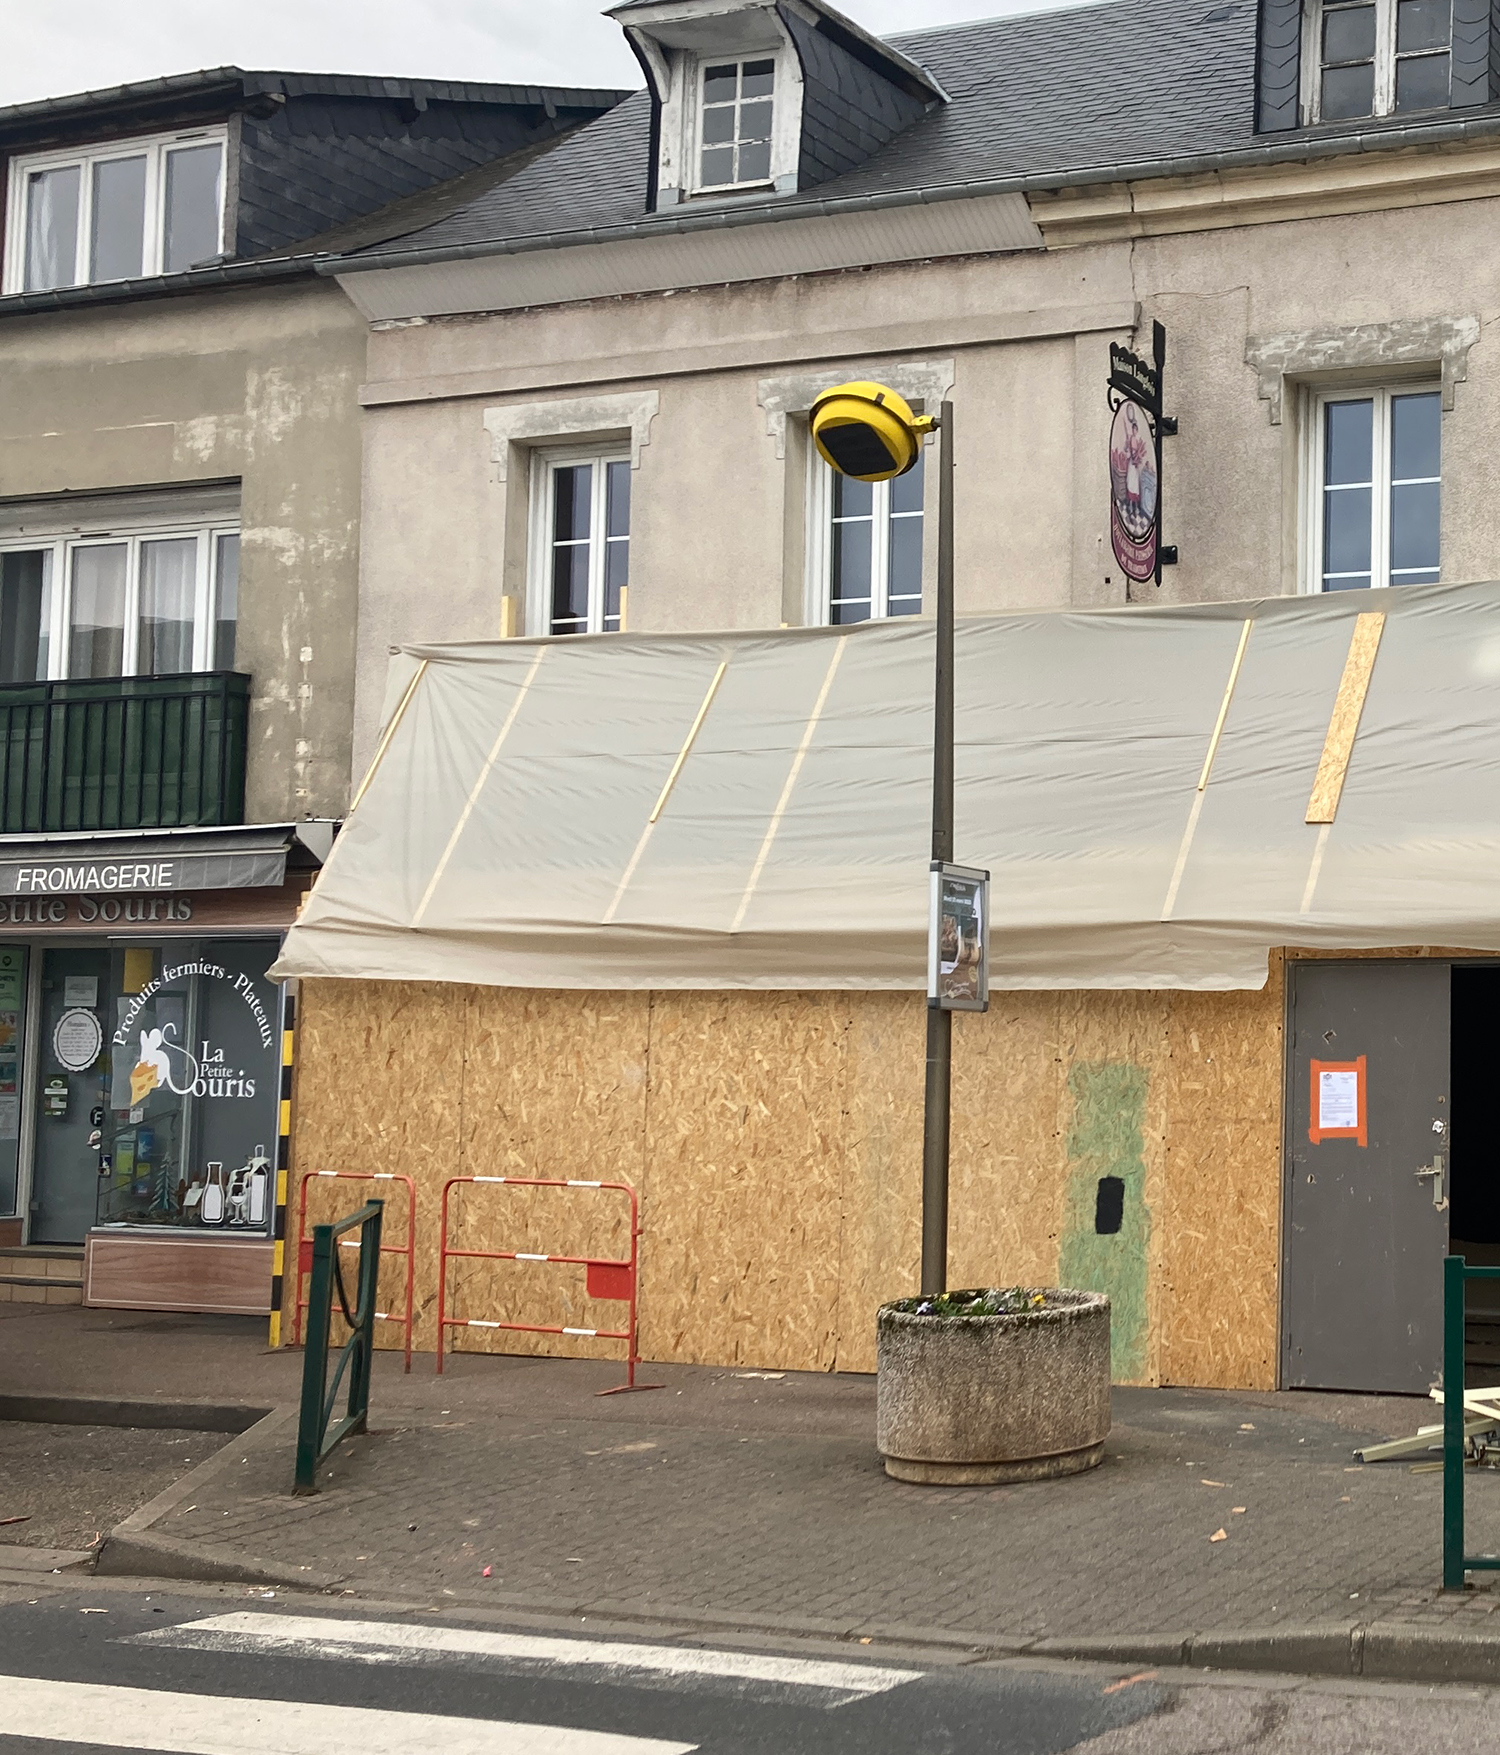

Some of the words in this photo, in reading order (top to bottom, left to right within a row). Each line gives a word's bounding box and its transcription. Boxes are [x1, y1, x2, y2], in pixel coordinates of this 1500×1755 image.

[16, 863, 174, 891] FROMAGERIE
[78, 895, 192, 922] Souris
[112, 976, 161, 1047] Produits
[162, 957, 226, 983] fermiers
[233, 972, 273, 1049] Plateaux
[201, 1040, 225, 1063] La
[200, 1063, 234, 1078] Petite
